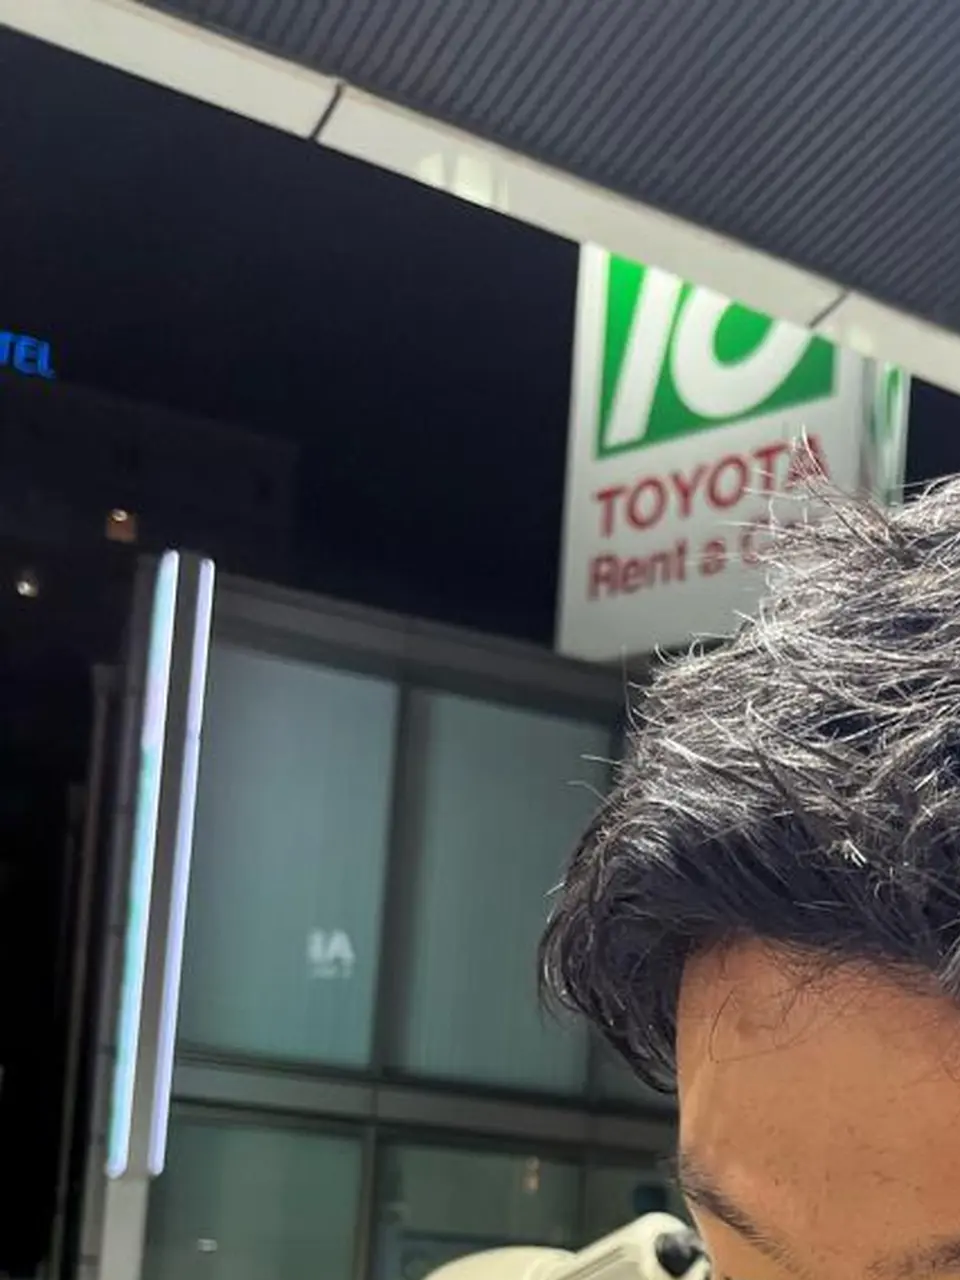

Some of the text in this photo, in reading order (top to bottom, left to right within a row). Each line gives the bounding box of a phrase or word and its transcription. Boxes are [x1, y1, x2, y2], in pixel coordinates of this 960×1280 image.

[595, 433, 830, 538] TOYOTA
[587, 538, 687, 600] Rent
[701, 537, 727, 577] a
